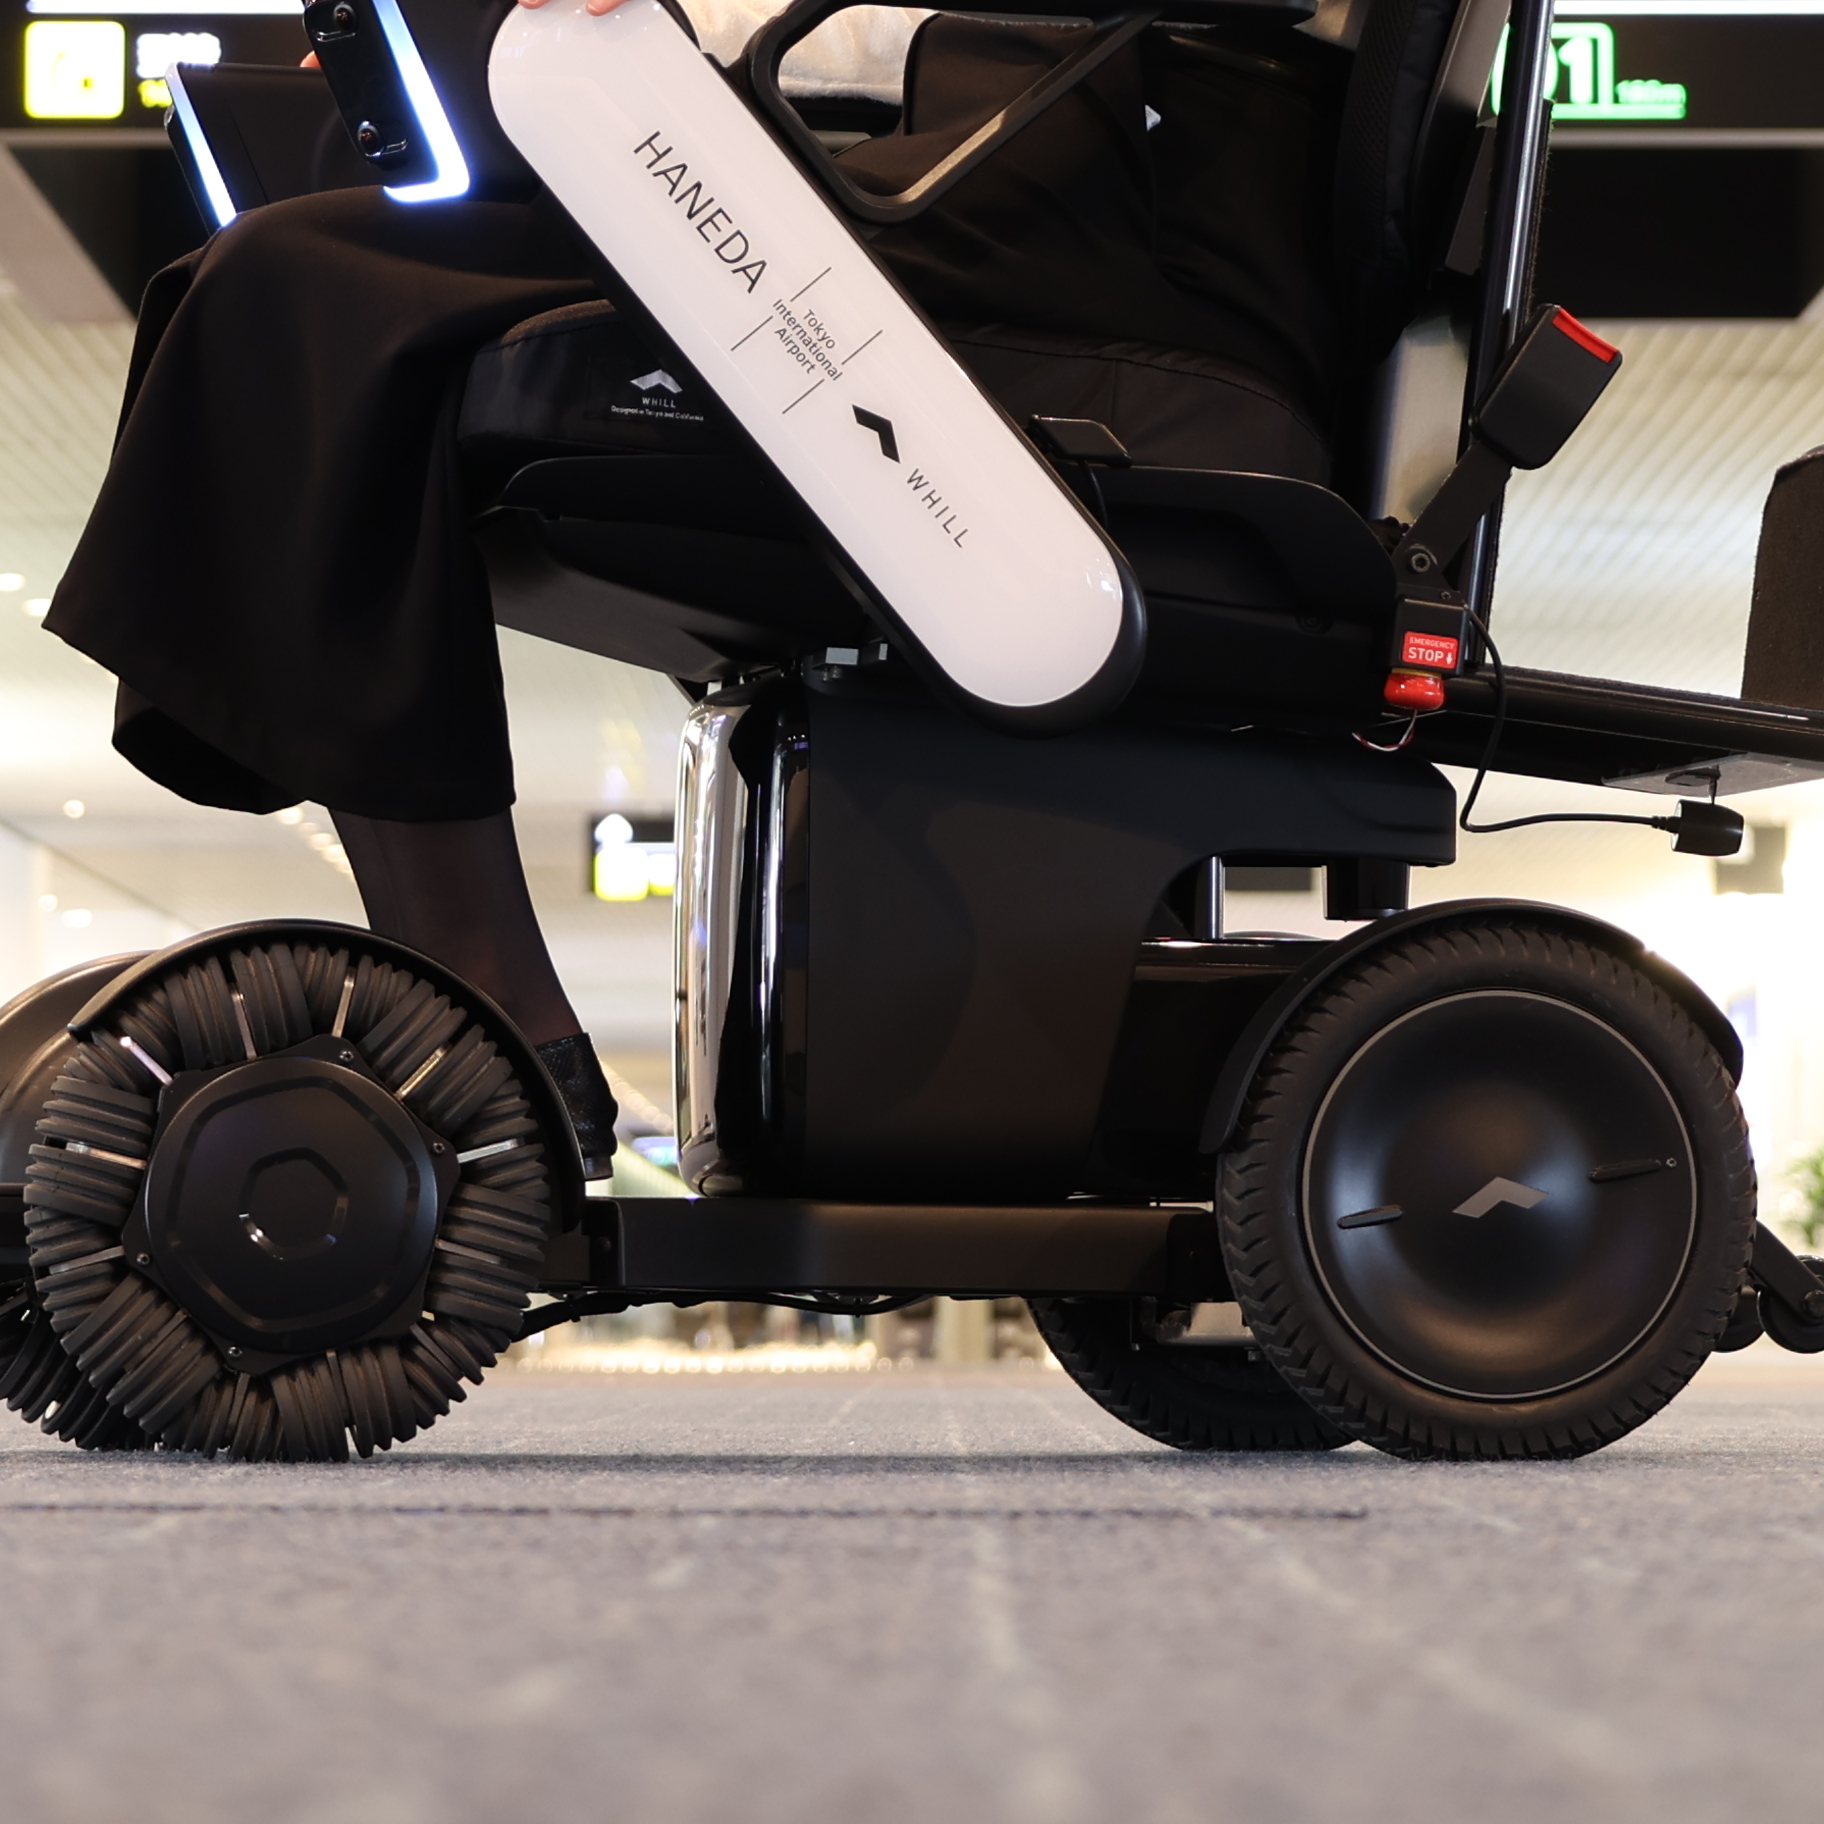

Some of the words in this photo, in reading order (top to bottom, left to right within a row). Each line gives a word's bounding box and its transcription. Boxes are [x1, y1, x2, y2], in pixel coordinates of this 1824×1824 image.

[633, 130, 768, 294] HANEDA
[772, 298, 843, 381] International
[774, 327, 816, 374] Airport
[803, 309, 836, 349] Tokyo
[642, 397, 676, 408] WHILL
[907, 468, 968, 548] WHILL
[1407, 647, 1444, 662] STOP
[1409, 636, 1455, 649] EMERGENCY
